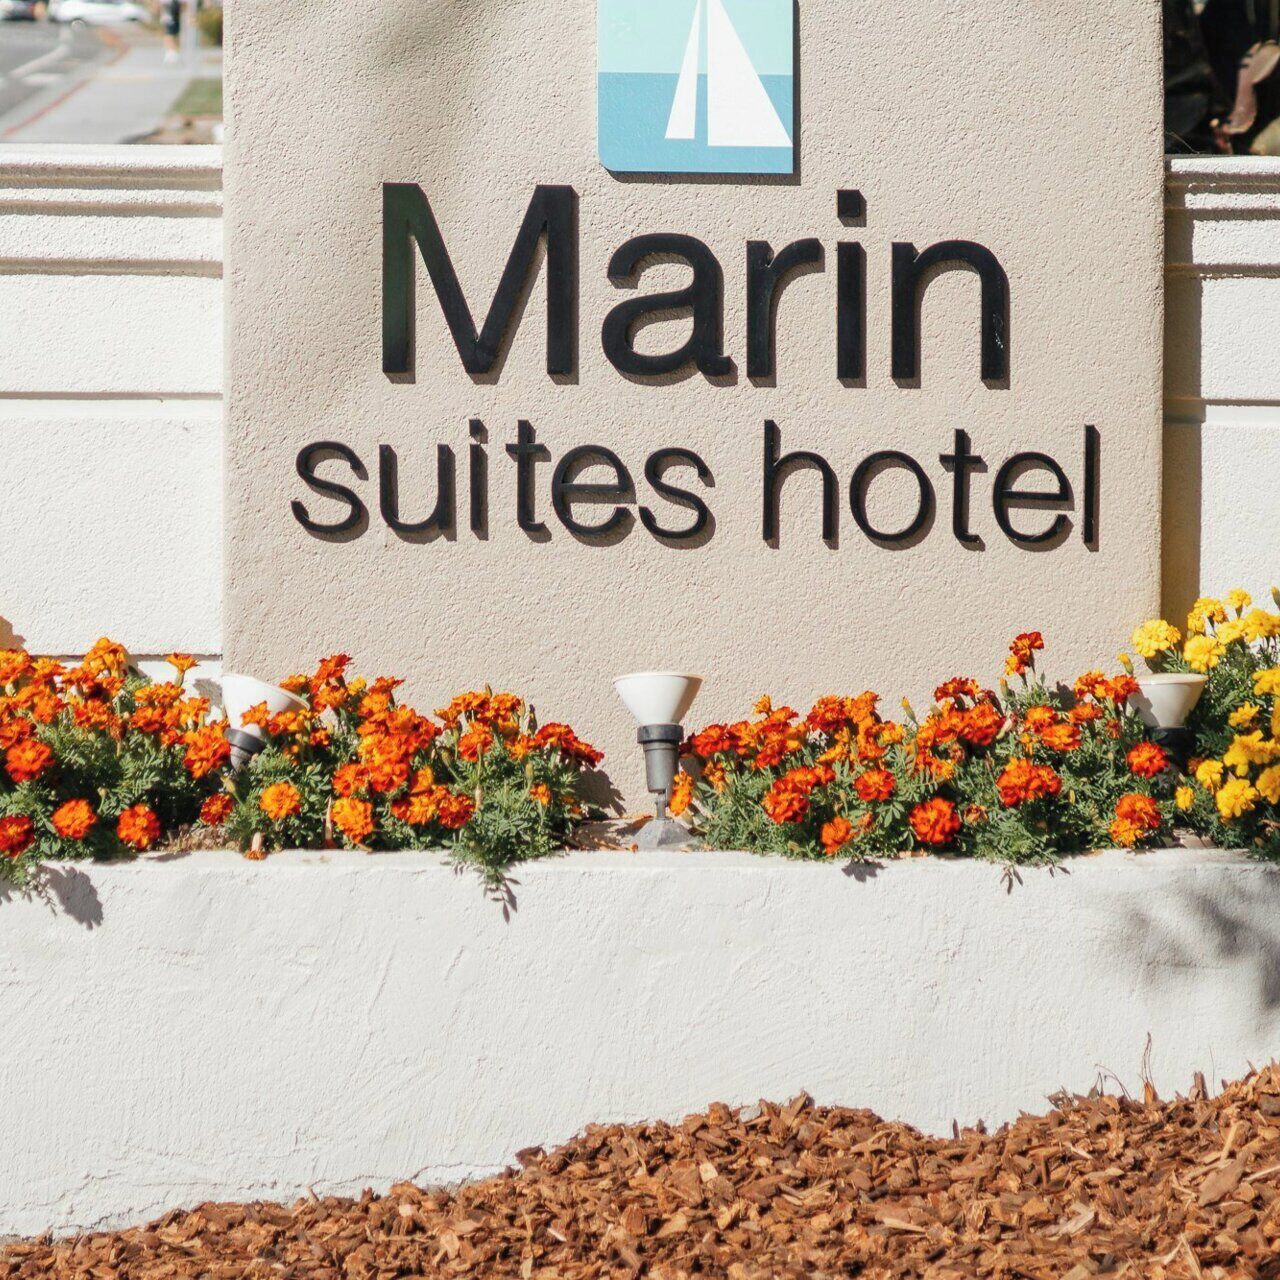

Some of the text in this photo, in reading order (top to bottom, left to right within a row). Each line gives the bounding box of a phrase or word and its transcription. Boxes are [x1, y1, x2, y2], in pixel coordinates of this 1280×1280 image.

[382, 182, 1010, 389] Marin
[291, 419, 1100, 551] suites hotel
